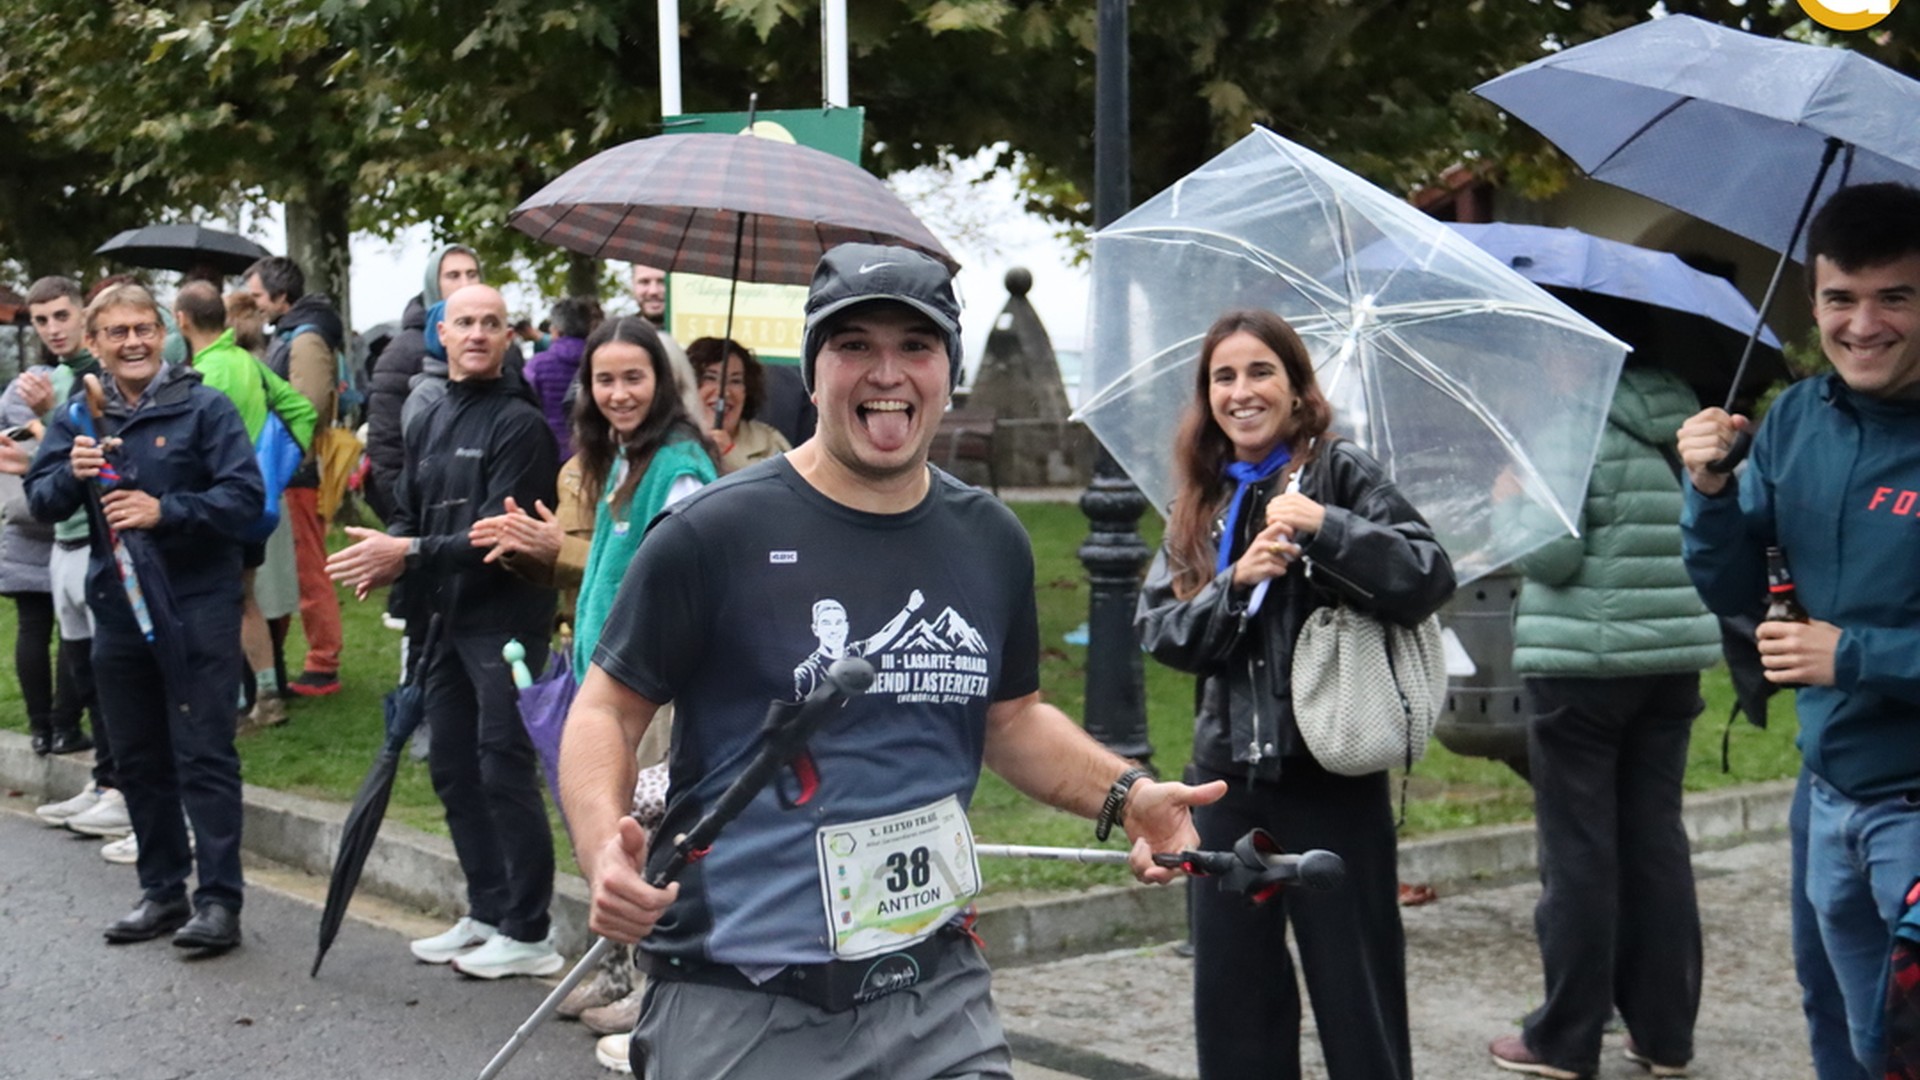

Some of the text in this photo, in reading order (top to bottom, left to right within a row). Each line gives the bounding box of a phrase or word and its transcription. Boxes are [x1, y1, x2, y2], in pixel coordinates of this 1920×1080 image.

[1867, 487, 1920, 517] FO
[913, 671, 989, 698] LASTERKETA
[886, 846, 930, 893] 38
[876, 886, 942, 916] ANTTON
